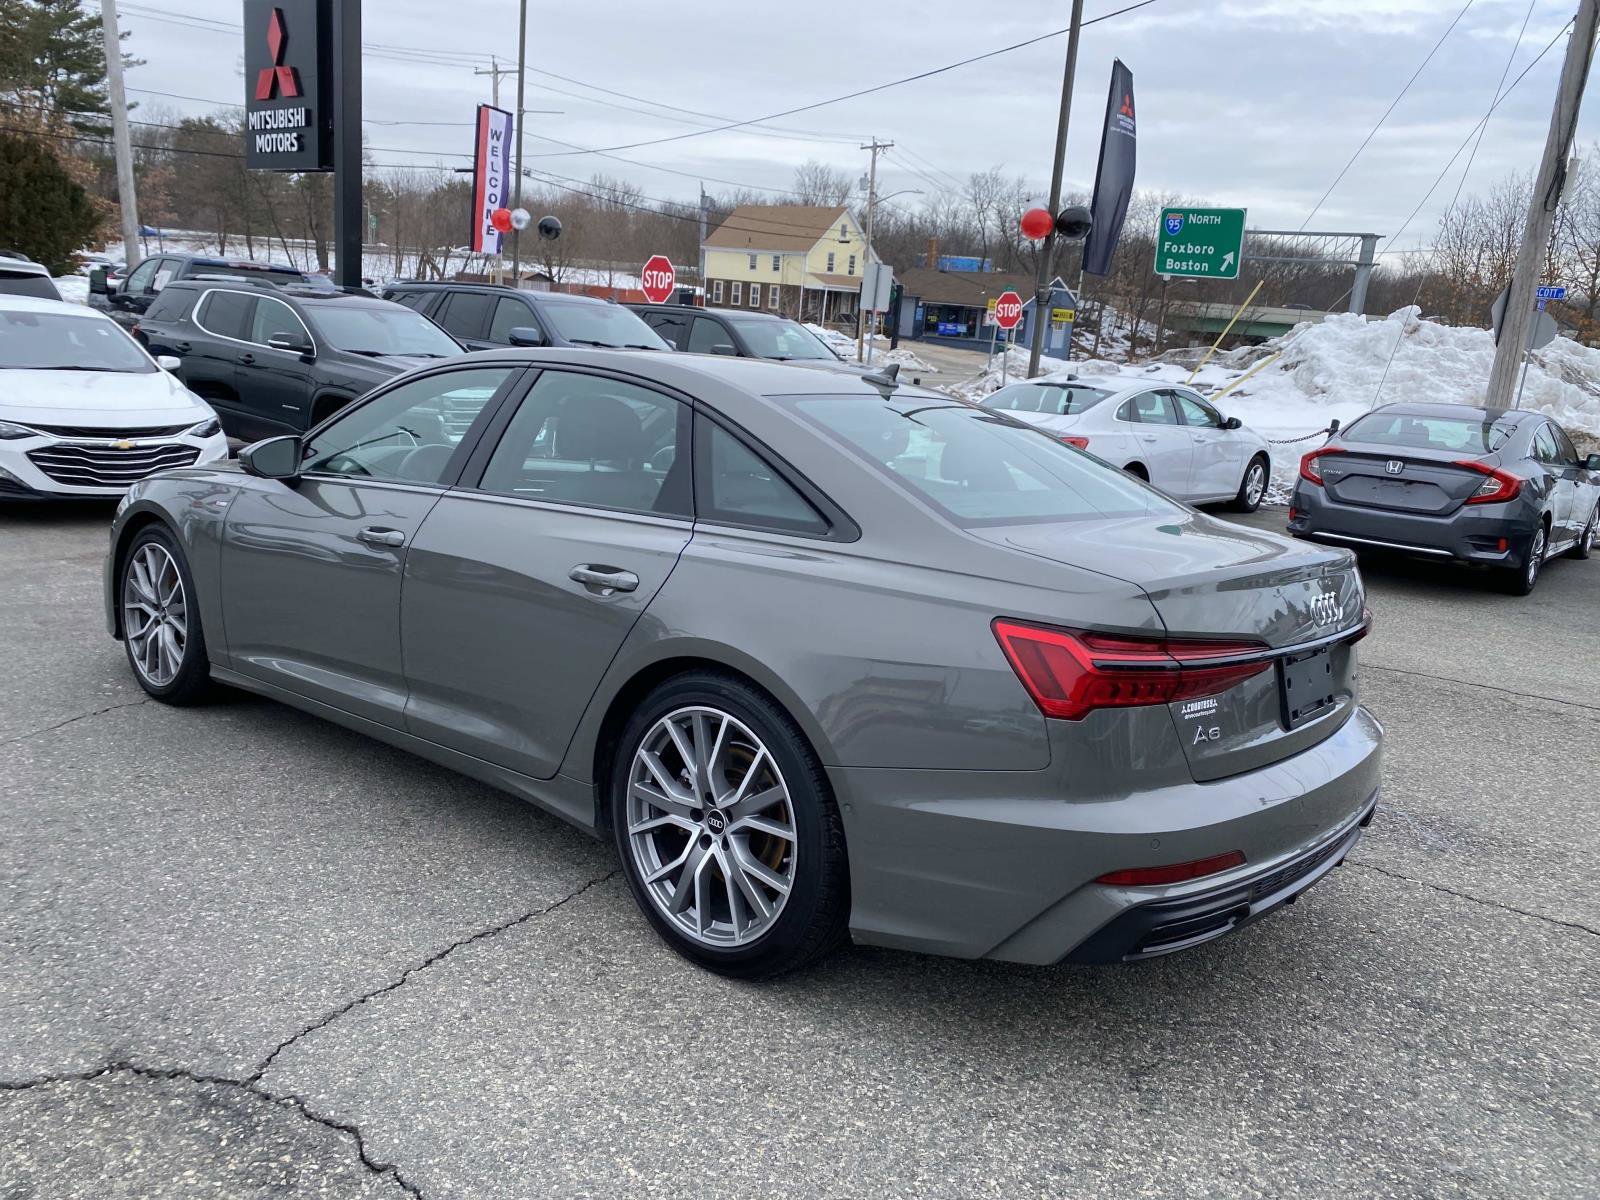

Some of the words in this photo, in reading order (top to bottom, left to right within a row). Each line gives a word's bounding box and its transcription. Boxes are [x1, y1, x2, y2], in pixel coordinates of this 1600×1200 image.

[248, 107, 305, 130] MITSUBISHI
[255, 132, 298, 153] MOTORS
[1168, 219, 1180, 230] 95
[1188, 213, 1221, 225] NORTH
[1164, 242, 1215, 255] Foxboro
[1166, 258, 1209, 272] Boston
[644, 270, 673, 290] STOP
[997, 303, 1021, 318] STOP
[1193, 725, 1221, 745] A6
